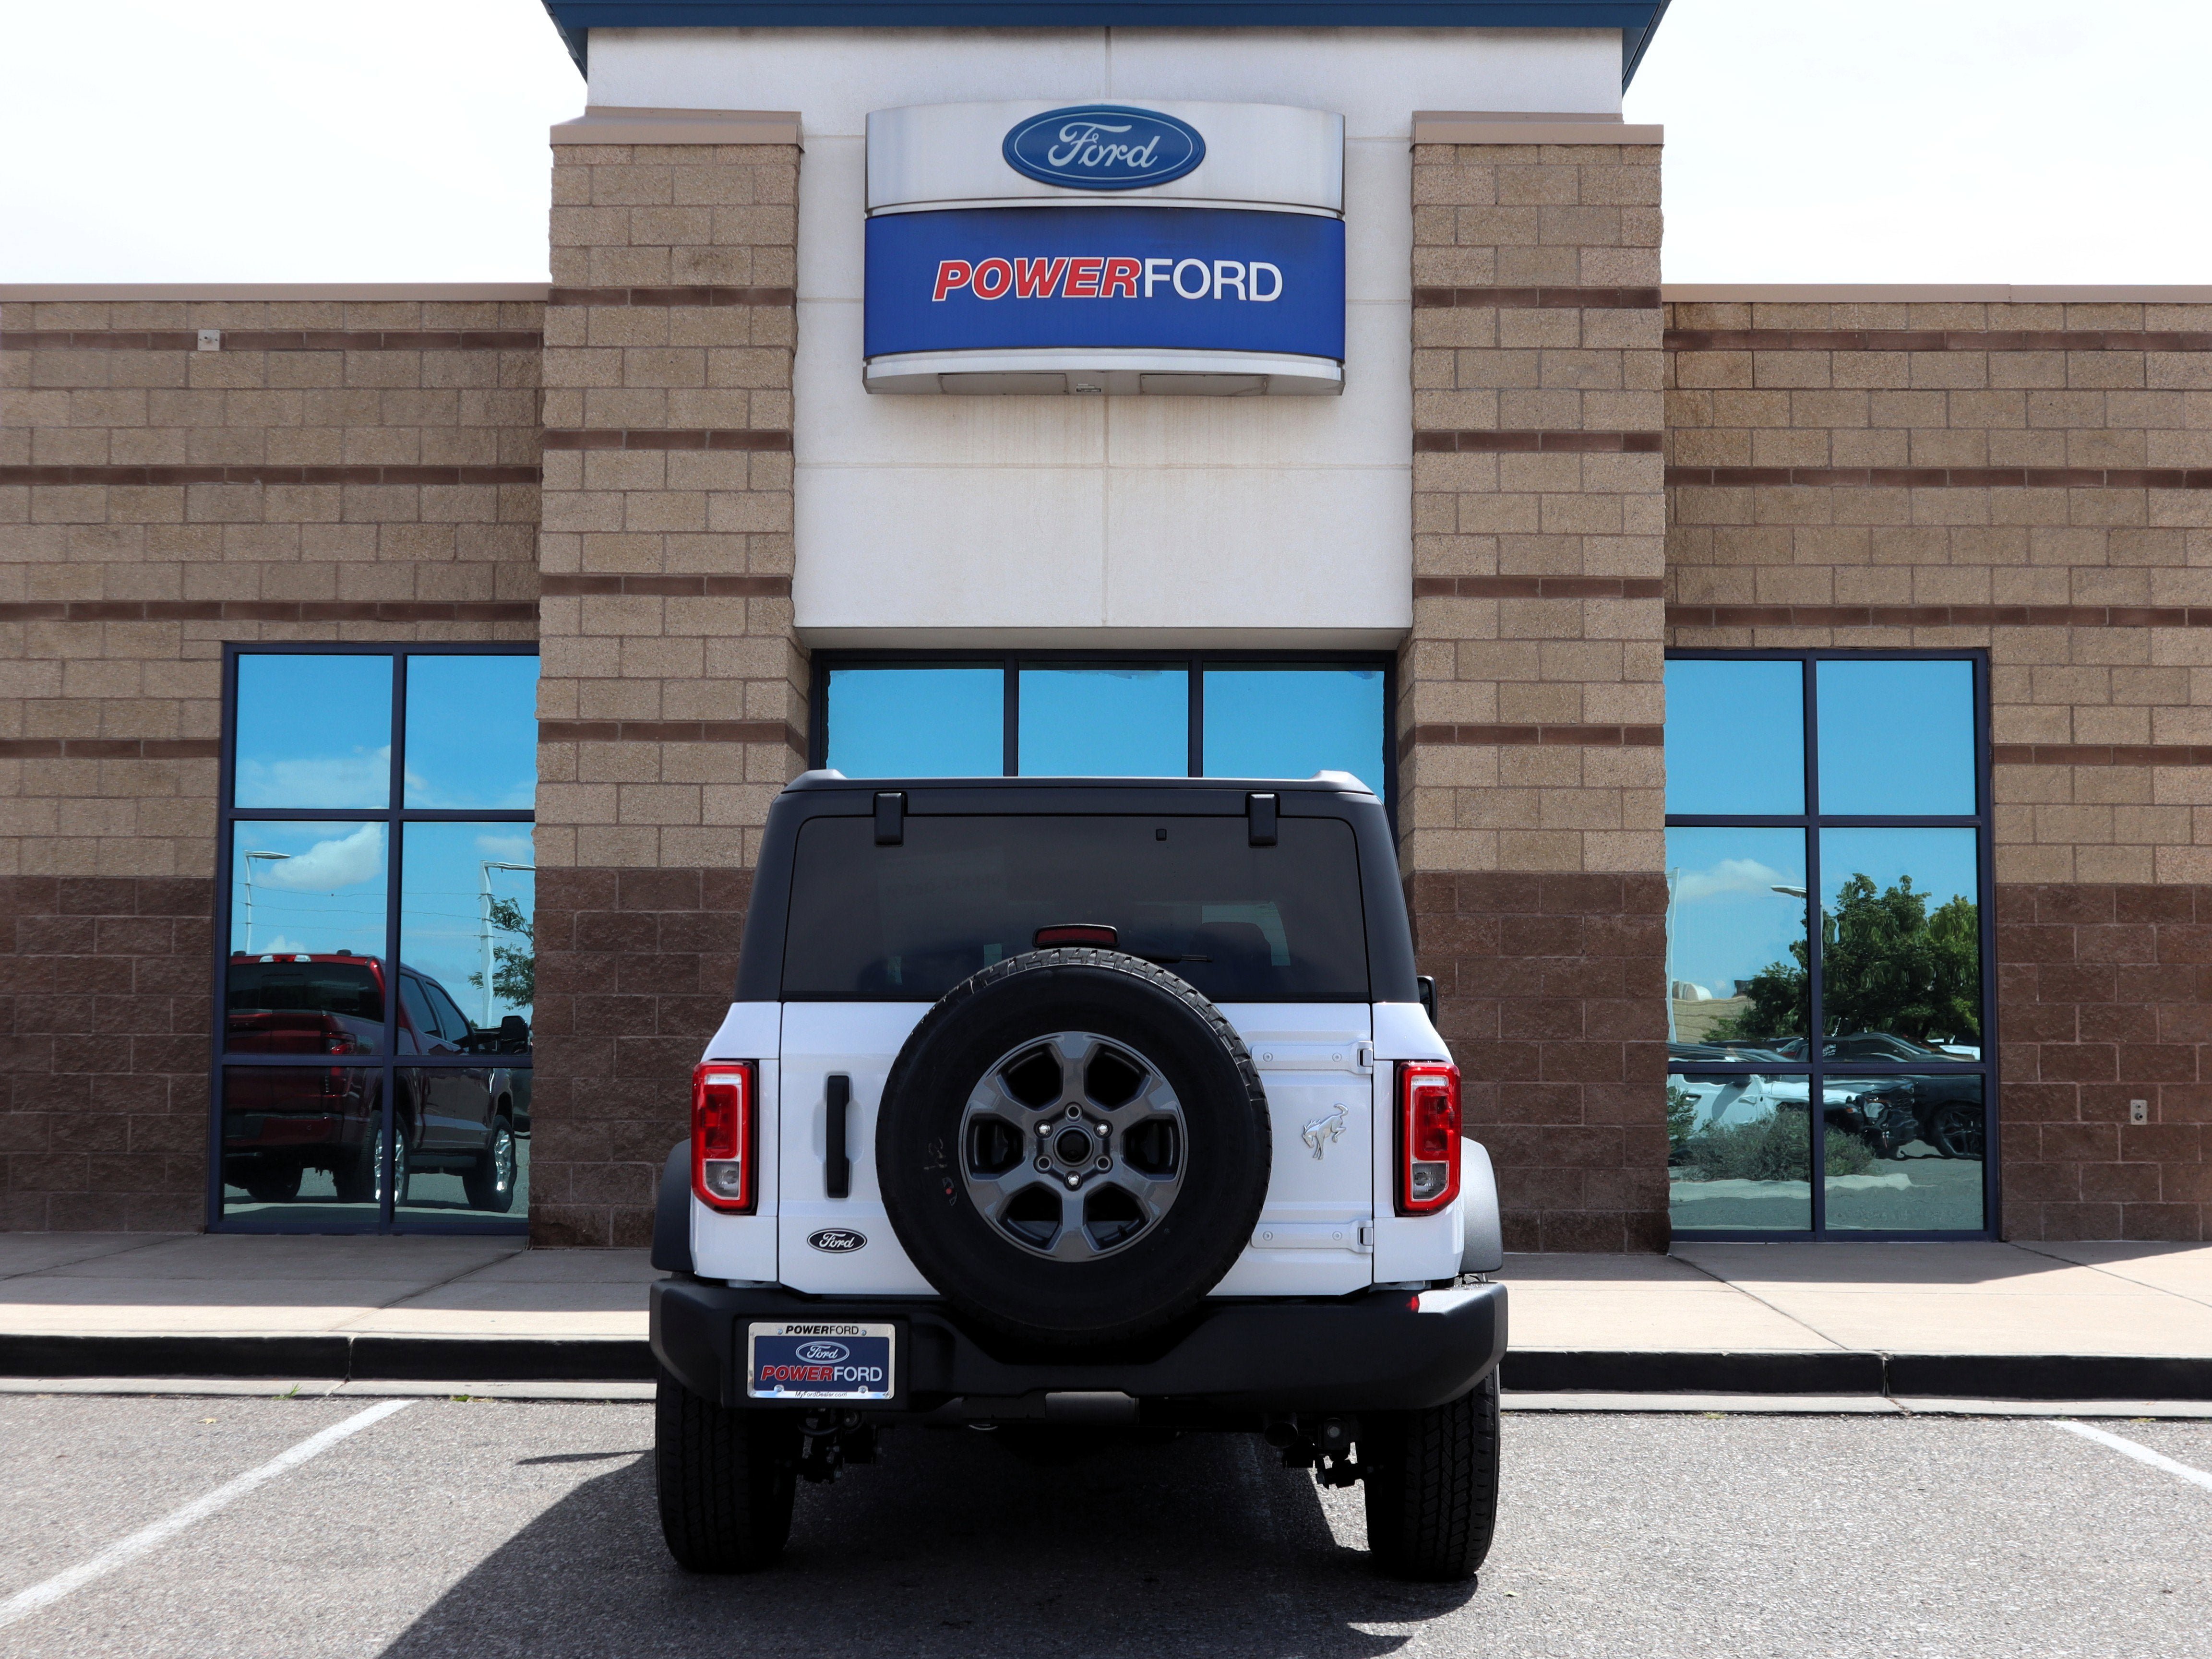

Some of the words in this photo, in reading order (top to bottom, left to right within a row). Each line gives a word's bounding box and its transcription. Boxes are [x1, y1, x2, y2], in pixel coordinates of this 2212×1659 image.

[1048, 121, 1160, 168] Ford
[932, 257, 1283, 303] POWERFORD
[819, 1232, 854, 1248] Ford
[786, 1325, 859, 1335] POWERFORD
[807, 1345, 838, 1359] Ford
[761, 1365, 883, 1382] POWERFORD
